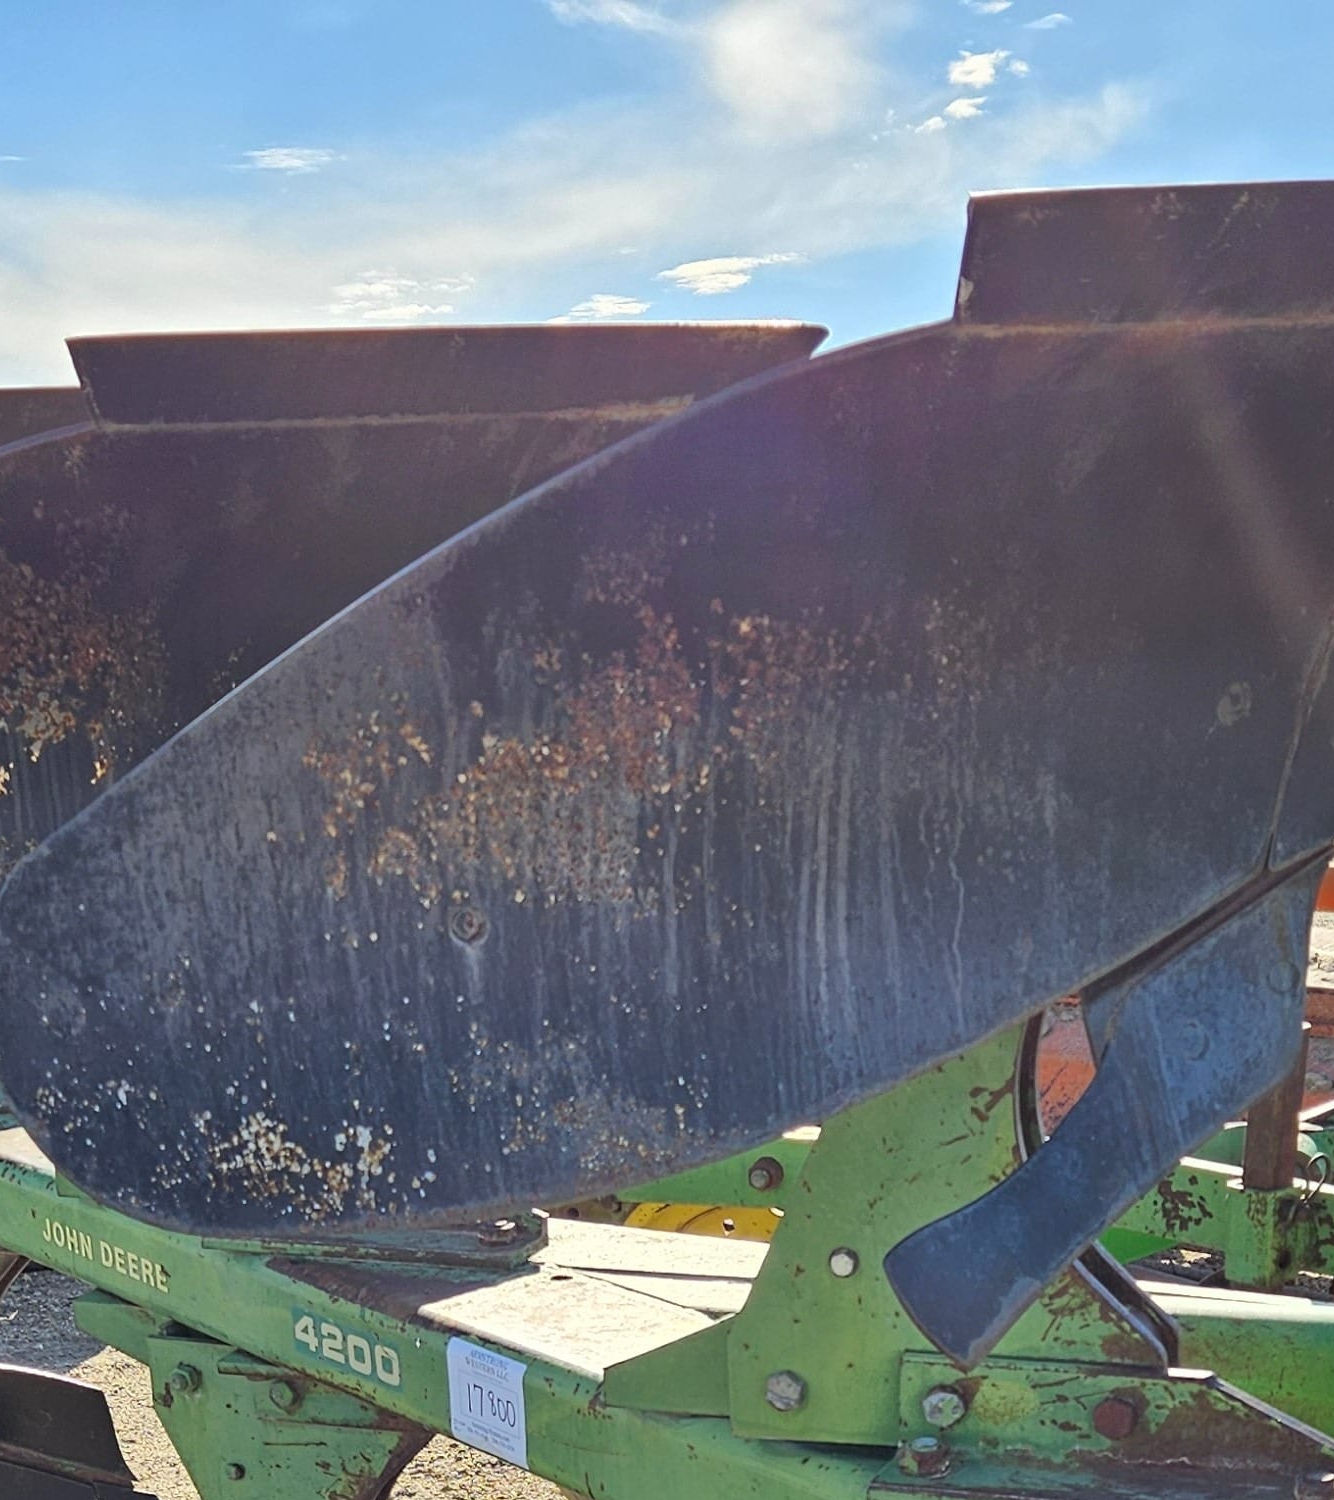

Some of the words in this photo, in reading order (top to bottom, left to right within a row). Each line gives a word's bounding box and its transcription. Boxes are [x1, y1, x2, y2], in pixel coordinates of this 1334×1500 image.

[43, 1218, 93, 1261] JOHN
[100, 1238, 170, 1293] DEERE
[295, 1315, 400, 1386] 4200
